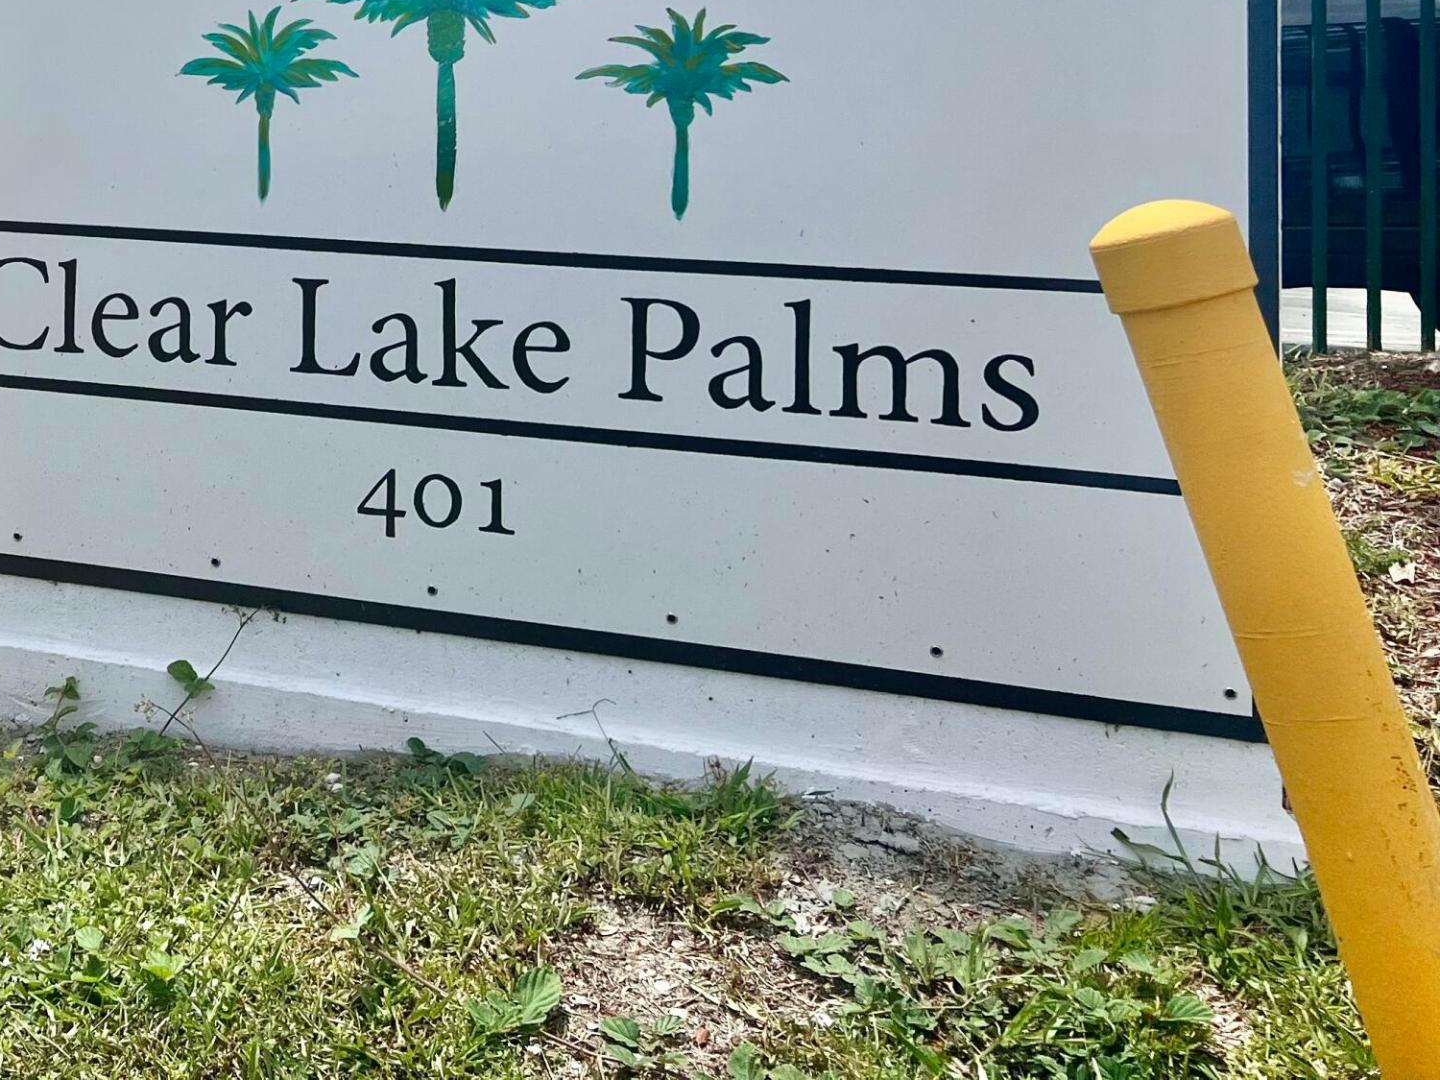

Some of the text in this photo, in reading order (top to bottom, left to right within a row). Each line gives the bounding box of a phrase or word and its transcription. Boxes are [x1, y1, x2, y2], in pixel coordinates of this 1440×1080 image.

[288, 276, 572, 395] Lake
[616, 295, 1042, 434] Palms
[355, 467, 518, 539] 401
